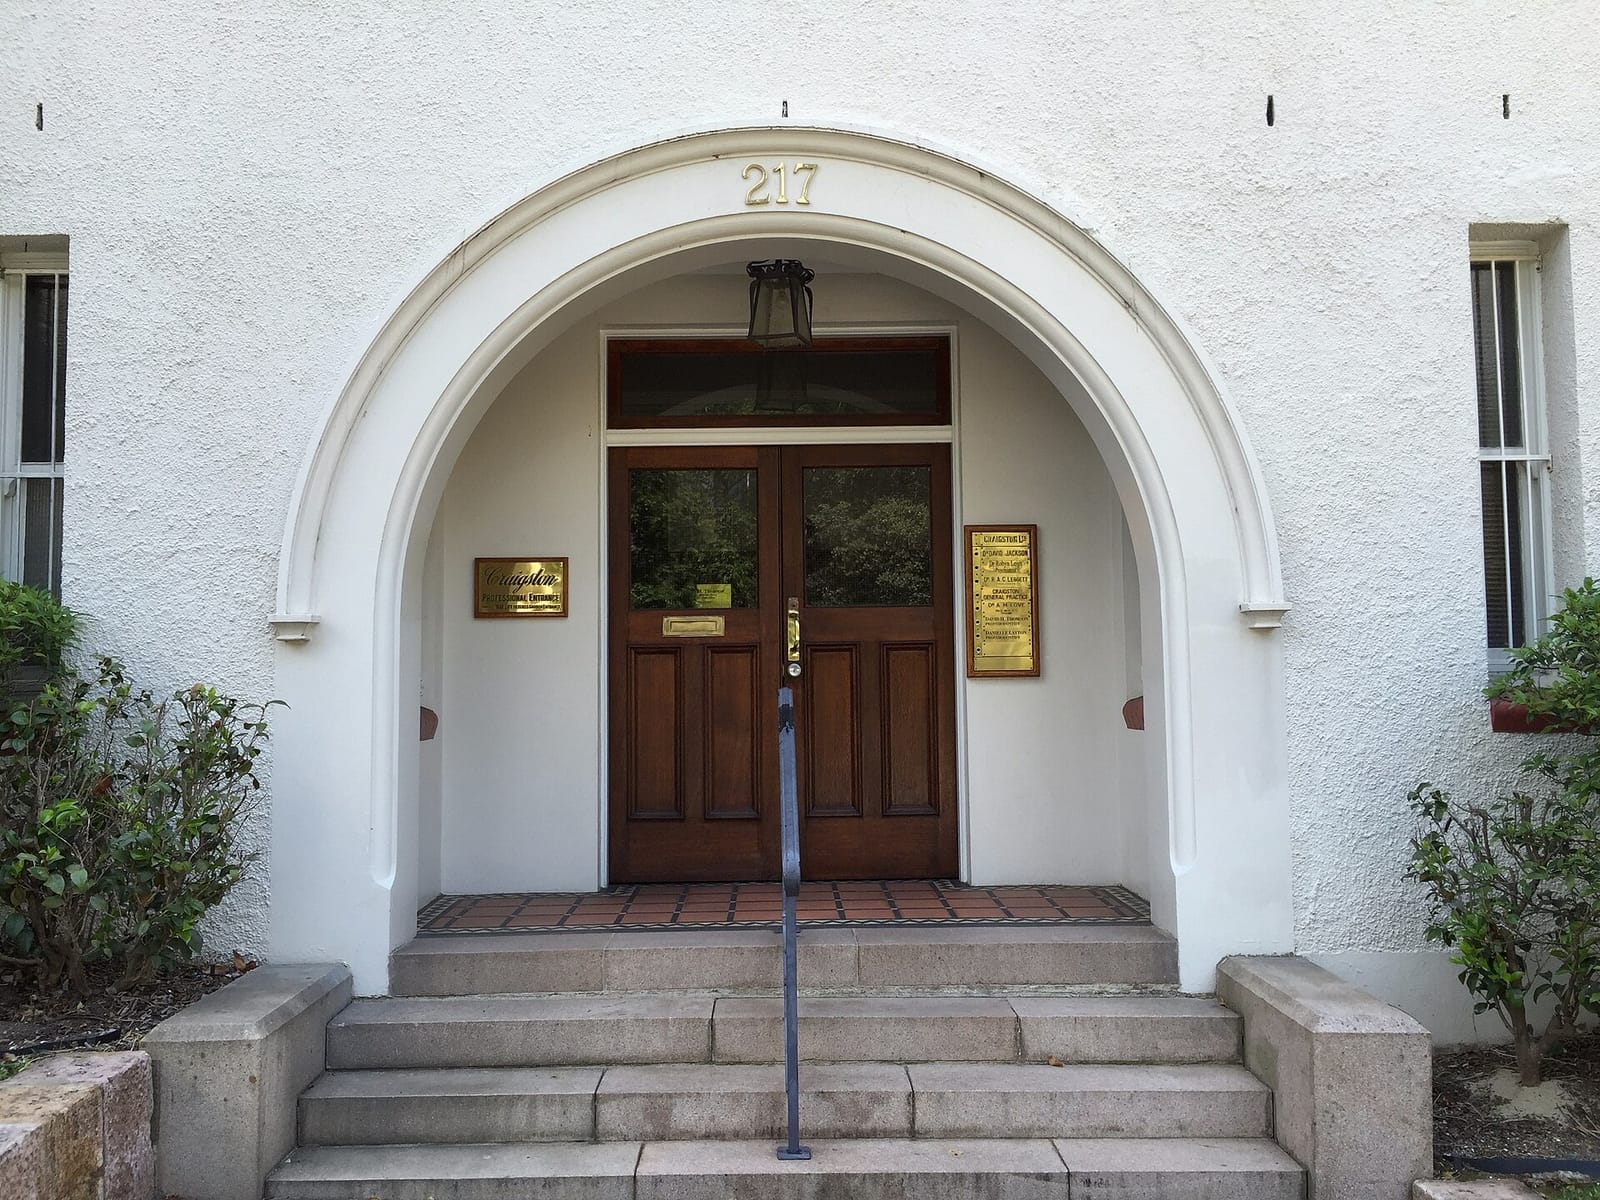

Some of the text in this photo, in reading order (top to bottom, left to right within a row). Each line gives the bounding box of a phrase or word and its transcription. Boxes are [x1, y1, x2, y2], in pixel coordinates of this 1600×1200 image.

[742, 161, 818, 205] 217
[485, 567, 560, 593] Craigston
[528, 593, 560, 602] ENTRANCE
